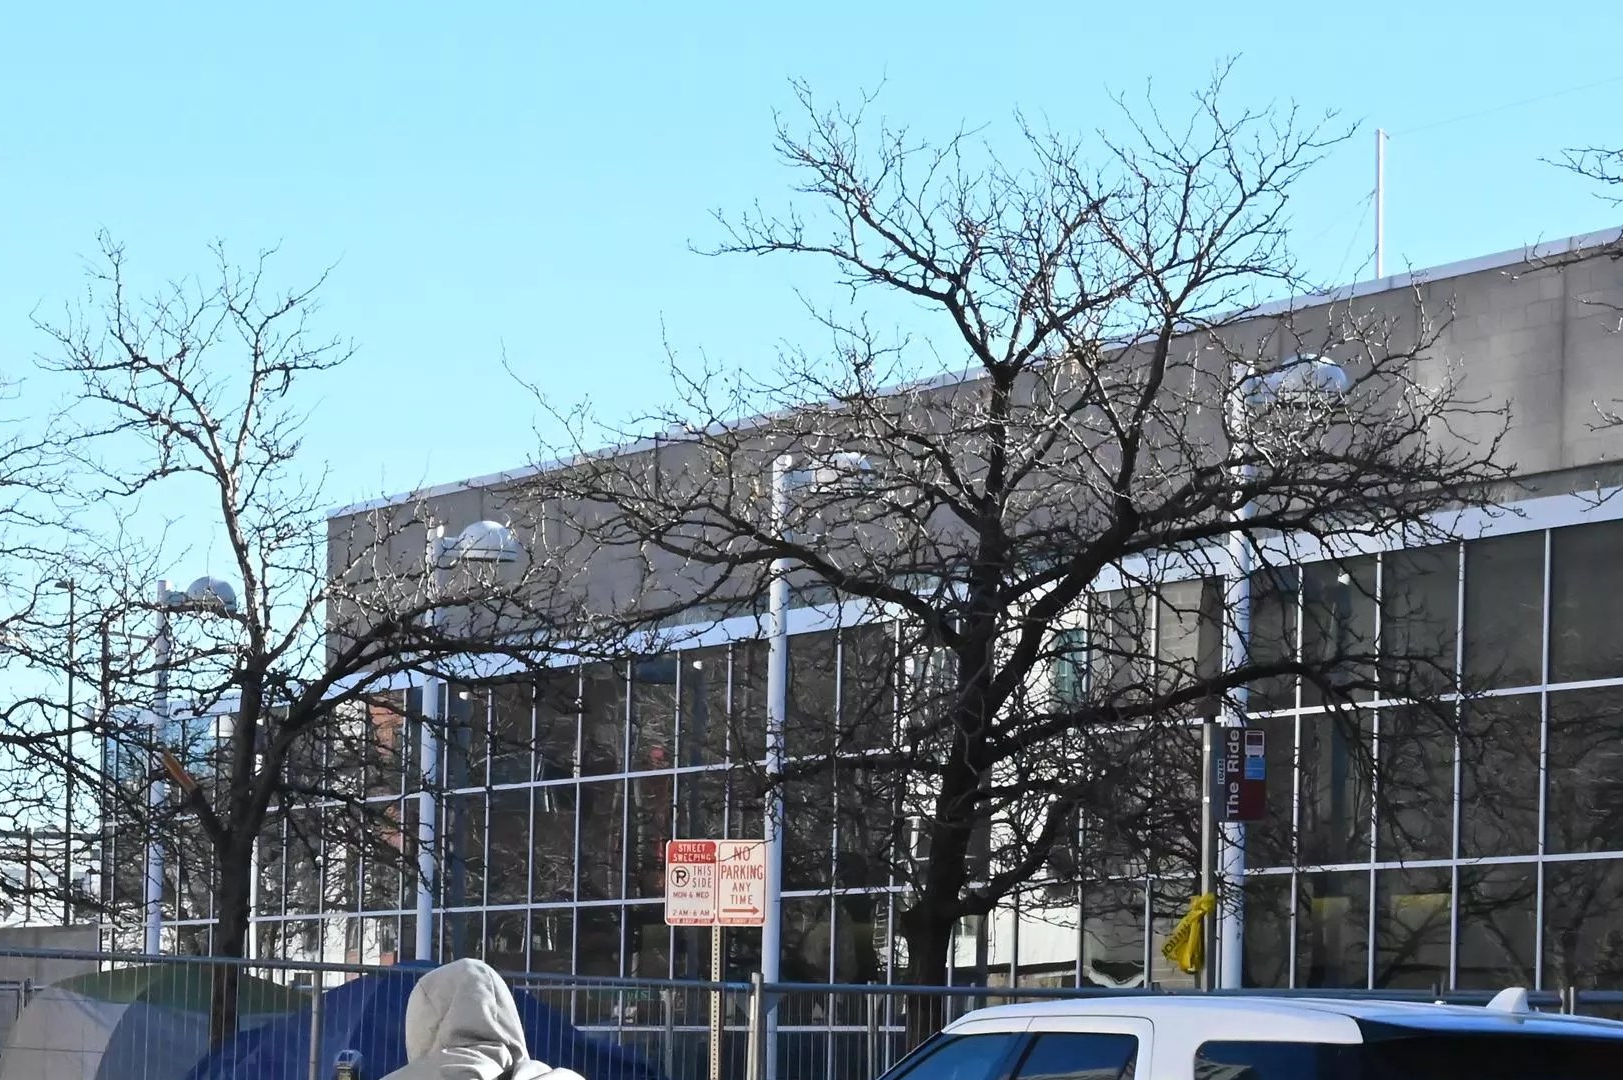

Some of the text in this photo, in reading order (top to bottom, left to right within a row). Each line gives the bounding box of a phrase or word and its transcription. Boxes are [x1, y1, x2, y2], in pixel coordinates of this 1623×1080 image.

[1227, 729, 1239, 817] The Ride
[678, 843, 706, 852] STREET
[673, 853, 711, 862] SWEEPING
[733, 846, 751, 861] NO
[693, 865, 712, 875] THIS
[720, 864, 764, 880] PARKING
[692, 878, 712, 888] SIDE
[732, 882, 752, 892] ANY
[730, 894, 753, 905] TIME
